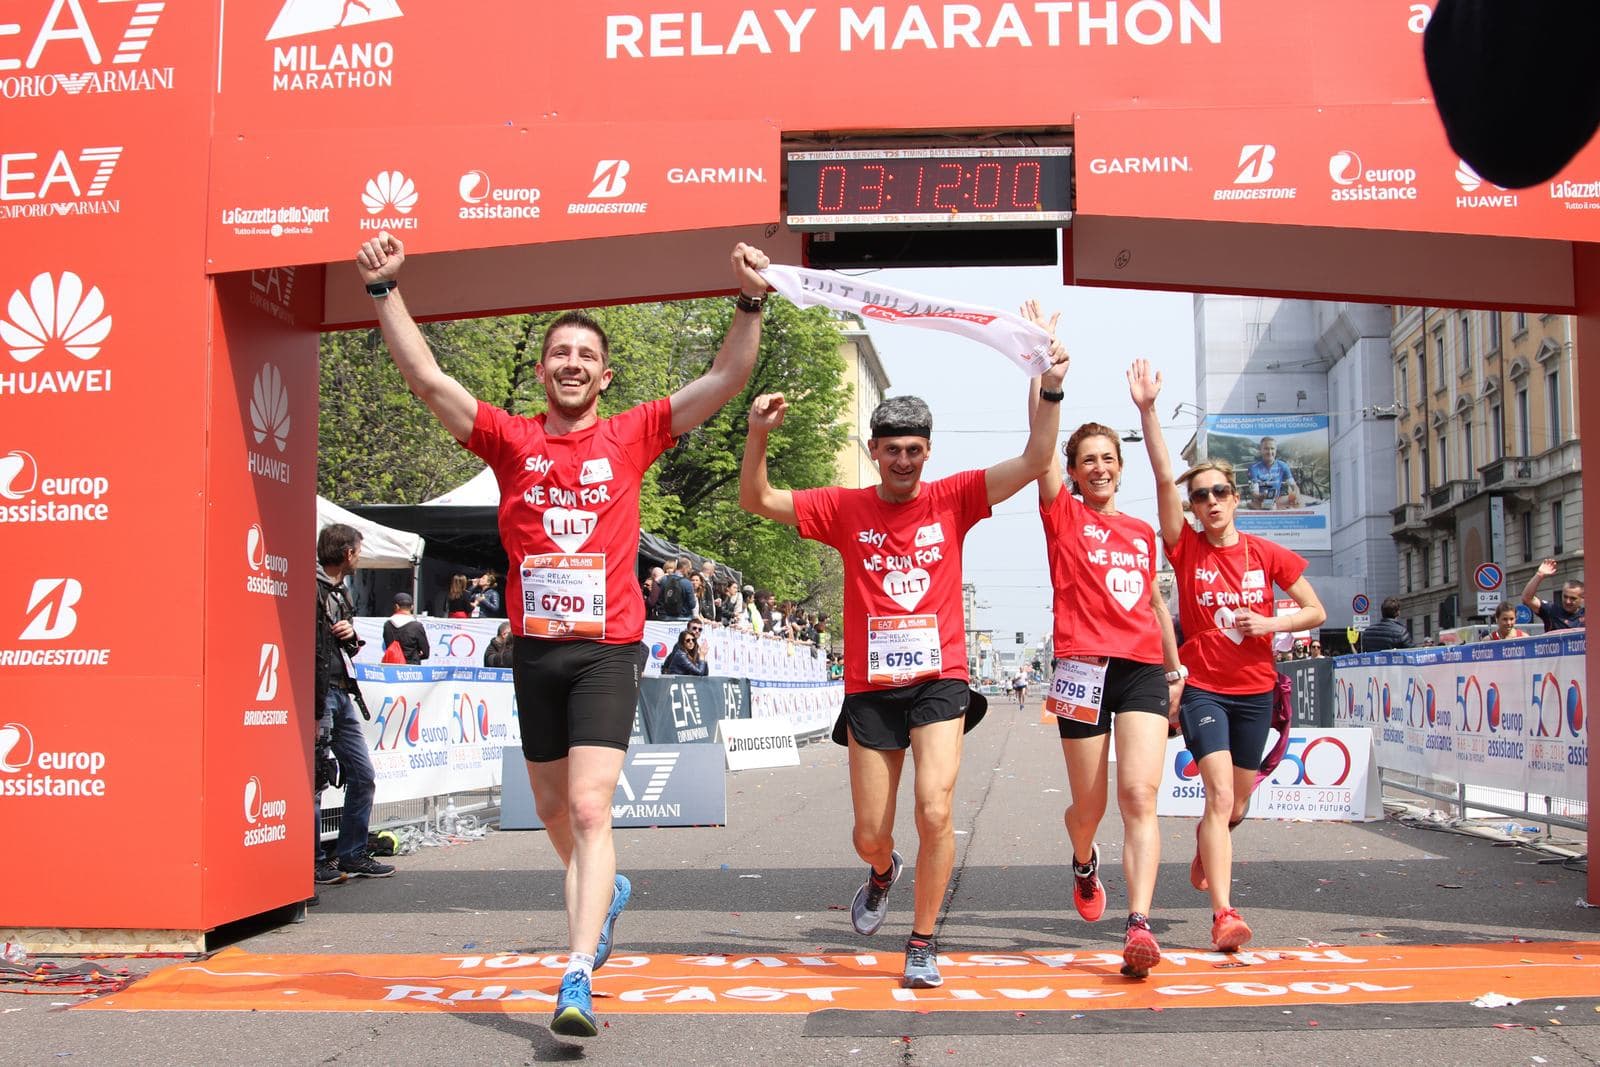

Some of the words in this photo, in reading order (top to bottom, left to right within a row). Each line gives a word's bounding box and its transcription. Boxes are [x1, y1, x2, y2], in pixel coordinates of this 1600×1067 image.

[605, 7, 817, 59] RELAY
[839, 0, 1223, 51] MARATHON
[272, 41, 394, 73] MILANO
[87, 67, 175, 93] ARMANI
[272, 71, 393, 91] MARATHON
[0, 146, 123, 200] EA7
[1365, 167, 1416, 184] europ
[492, 187, 541, 205] europ
[816, 161, 1041, 211] 03:12:00
[1213, 187, 1297, 201] BRIDGESTONE
[1331, 184, 1417, 201] assistance
[72, 200, 120, 215] ARMANI
[458, 203, 541, 219] assistance
[567, 202, 648, 214] BRIDGESTONE
[1455, 195, 1518, 208] HUAWEI
[301, 206, 330, 226] Sport
[359, 217, 418, 231] HUAWEI
[0, 369, 112, 395] HUAWEI
[247, 450, 291, 485] HUAWEI
[524, 454, 555, 477] sky
[41, 475, 109, 500] europ
[523, 485, 546, 506] WE
[549, 486, 577, 507] RUN
[579, 484, 611, 506] FOR
[0, 499, 109, 523] assistance
[549, 517, 594, 536] LILT
[1083, 524, 1111, 544] sky
[859, 528, 887, 549] sky
[264, 552, 288, 576] europ
[863, 554, 883, 572] WE
[886, 555, 914, 572] RUN
[915, 546, 943, 566] FOR
[1087, 549, 1108, 565] WE
[1110, 551, 1136, 568] RUN
[247, 573, 288, 598] assistance
[547, 572, 571, 580] RELAY
[1113, 577, 1141, 594] LILT
[1194, 568, 1219, 585] sky
[890, 577, 927, 596] LILT
[541, 594, 585, 613] 679D
[1216, 590, 1240, 606] RUN
[1241, 589, 1264, 605] FOR
[886, 651, 924, 667] 679C
[1055, 678, 1086, 699] 679B
[243, 709, 288, 726] BRIDGESTONE
[1055, 700, 1077, 715] EA7
[421, 725, 449, 743] europ
[1501, 712, 1523, 736] europ
[728, 735, 793, 752] BRIDGESTONE
[1487, 735, 1524, 760] assistance
[38, 751, 106, 775] europ
[1271, 736, 1352, 786] 50
[1269, 790, 1301, 803] 1968
[1318, 791, 1352, 803] 2018
[262, 799, 287, 820] europ
[626, 803, 681, 818] ARMANI
[1268, 803, 1274, 811] A
[1276, 803, 1305, 812] PROVA
[1308, 804, 1317, 812] DI
[1319, 804, 1351, 813] FUTURO
[244, 822, 287, 847] assistance
[890, 985, 1127, 1002] LIVE
[1153, 980, 1414, 996] COOL
